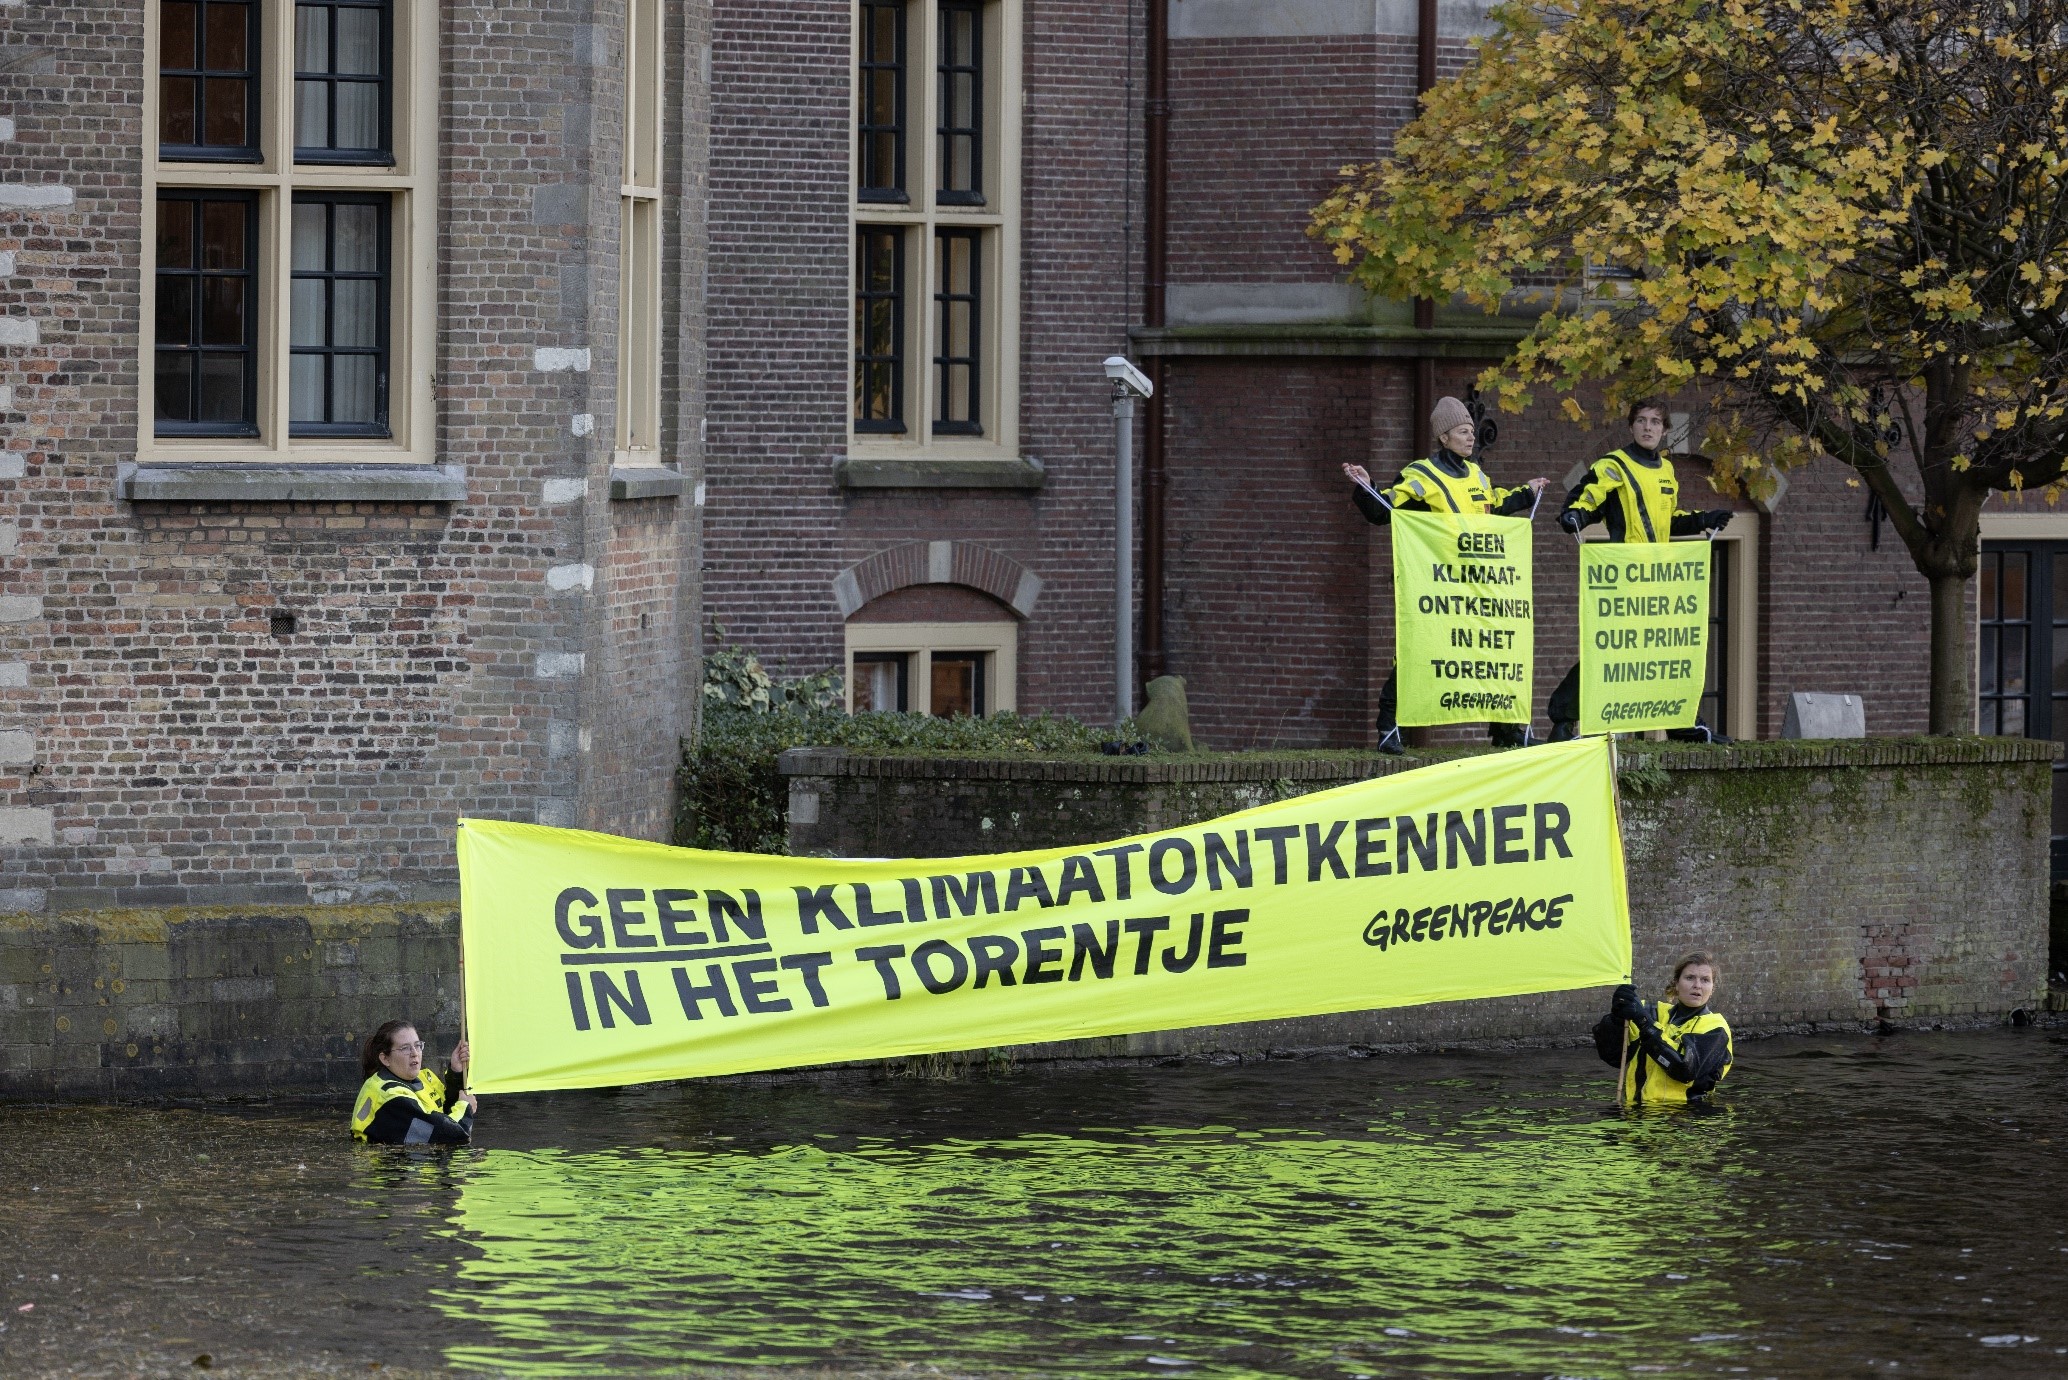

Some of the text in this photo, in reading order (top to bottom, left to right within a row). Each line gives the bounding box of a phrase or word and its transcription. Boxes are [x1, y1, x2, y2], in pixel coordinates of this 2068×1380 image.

[1457, 532, 1505, 553] GEEN
[1433, 563, 1521, 586] KLIMAAT-
[1588, 561, 1705, 584] NO CLIMATE
[1418, 595, 1531, 619] ONTKENNER
[1598, 594, 1698, 617] DENIER AS
[1451, 628, 1516, 650] IN HET
[1595, 627, 1701, 650] OUR PRIME
[1431, 659, 1524, 682] TORENTJE
[1603, 659, 1692, 683] MINISTER
[1440, 692, 1517, 711] GREENPEACE
[1601, 698, 1687, 724] GREENPEACE
[554, 801, 1573, 950] GEEN KLIMAATONTKENNER
[1362, 893, 1574, 952] GREENPEACE
[565, 908, 1250, 1031] IN HET TORENTJE
